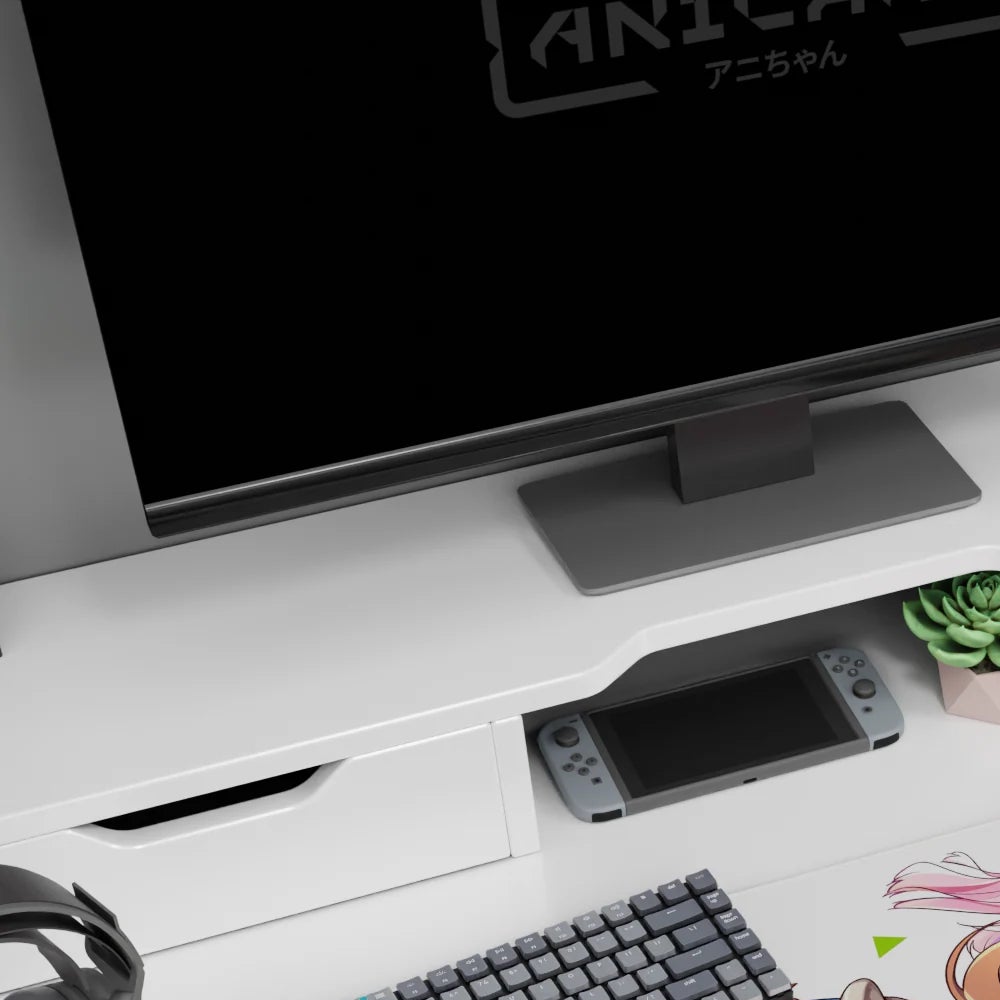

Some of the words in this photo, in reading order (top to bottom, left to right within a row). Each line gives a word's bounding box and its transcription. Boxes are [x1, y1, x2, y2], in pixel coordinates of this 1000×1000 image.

[705, 40, 847, 89] アニちゃん
